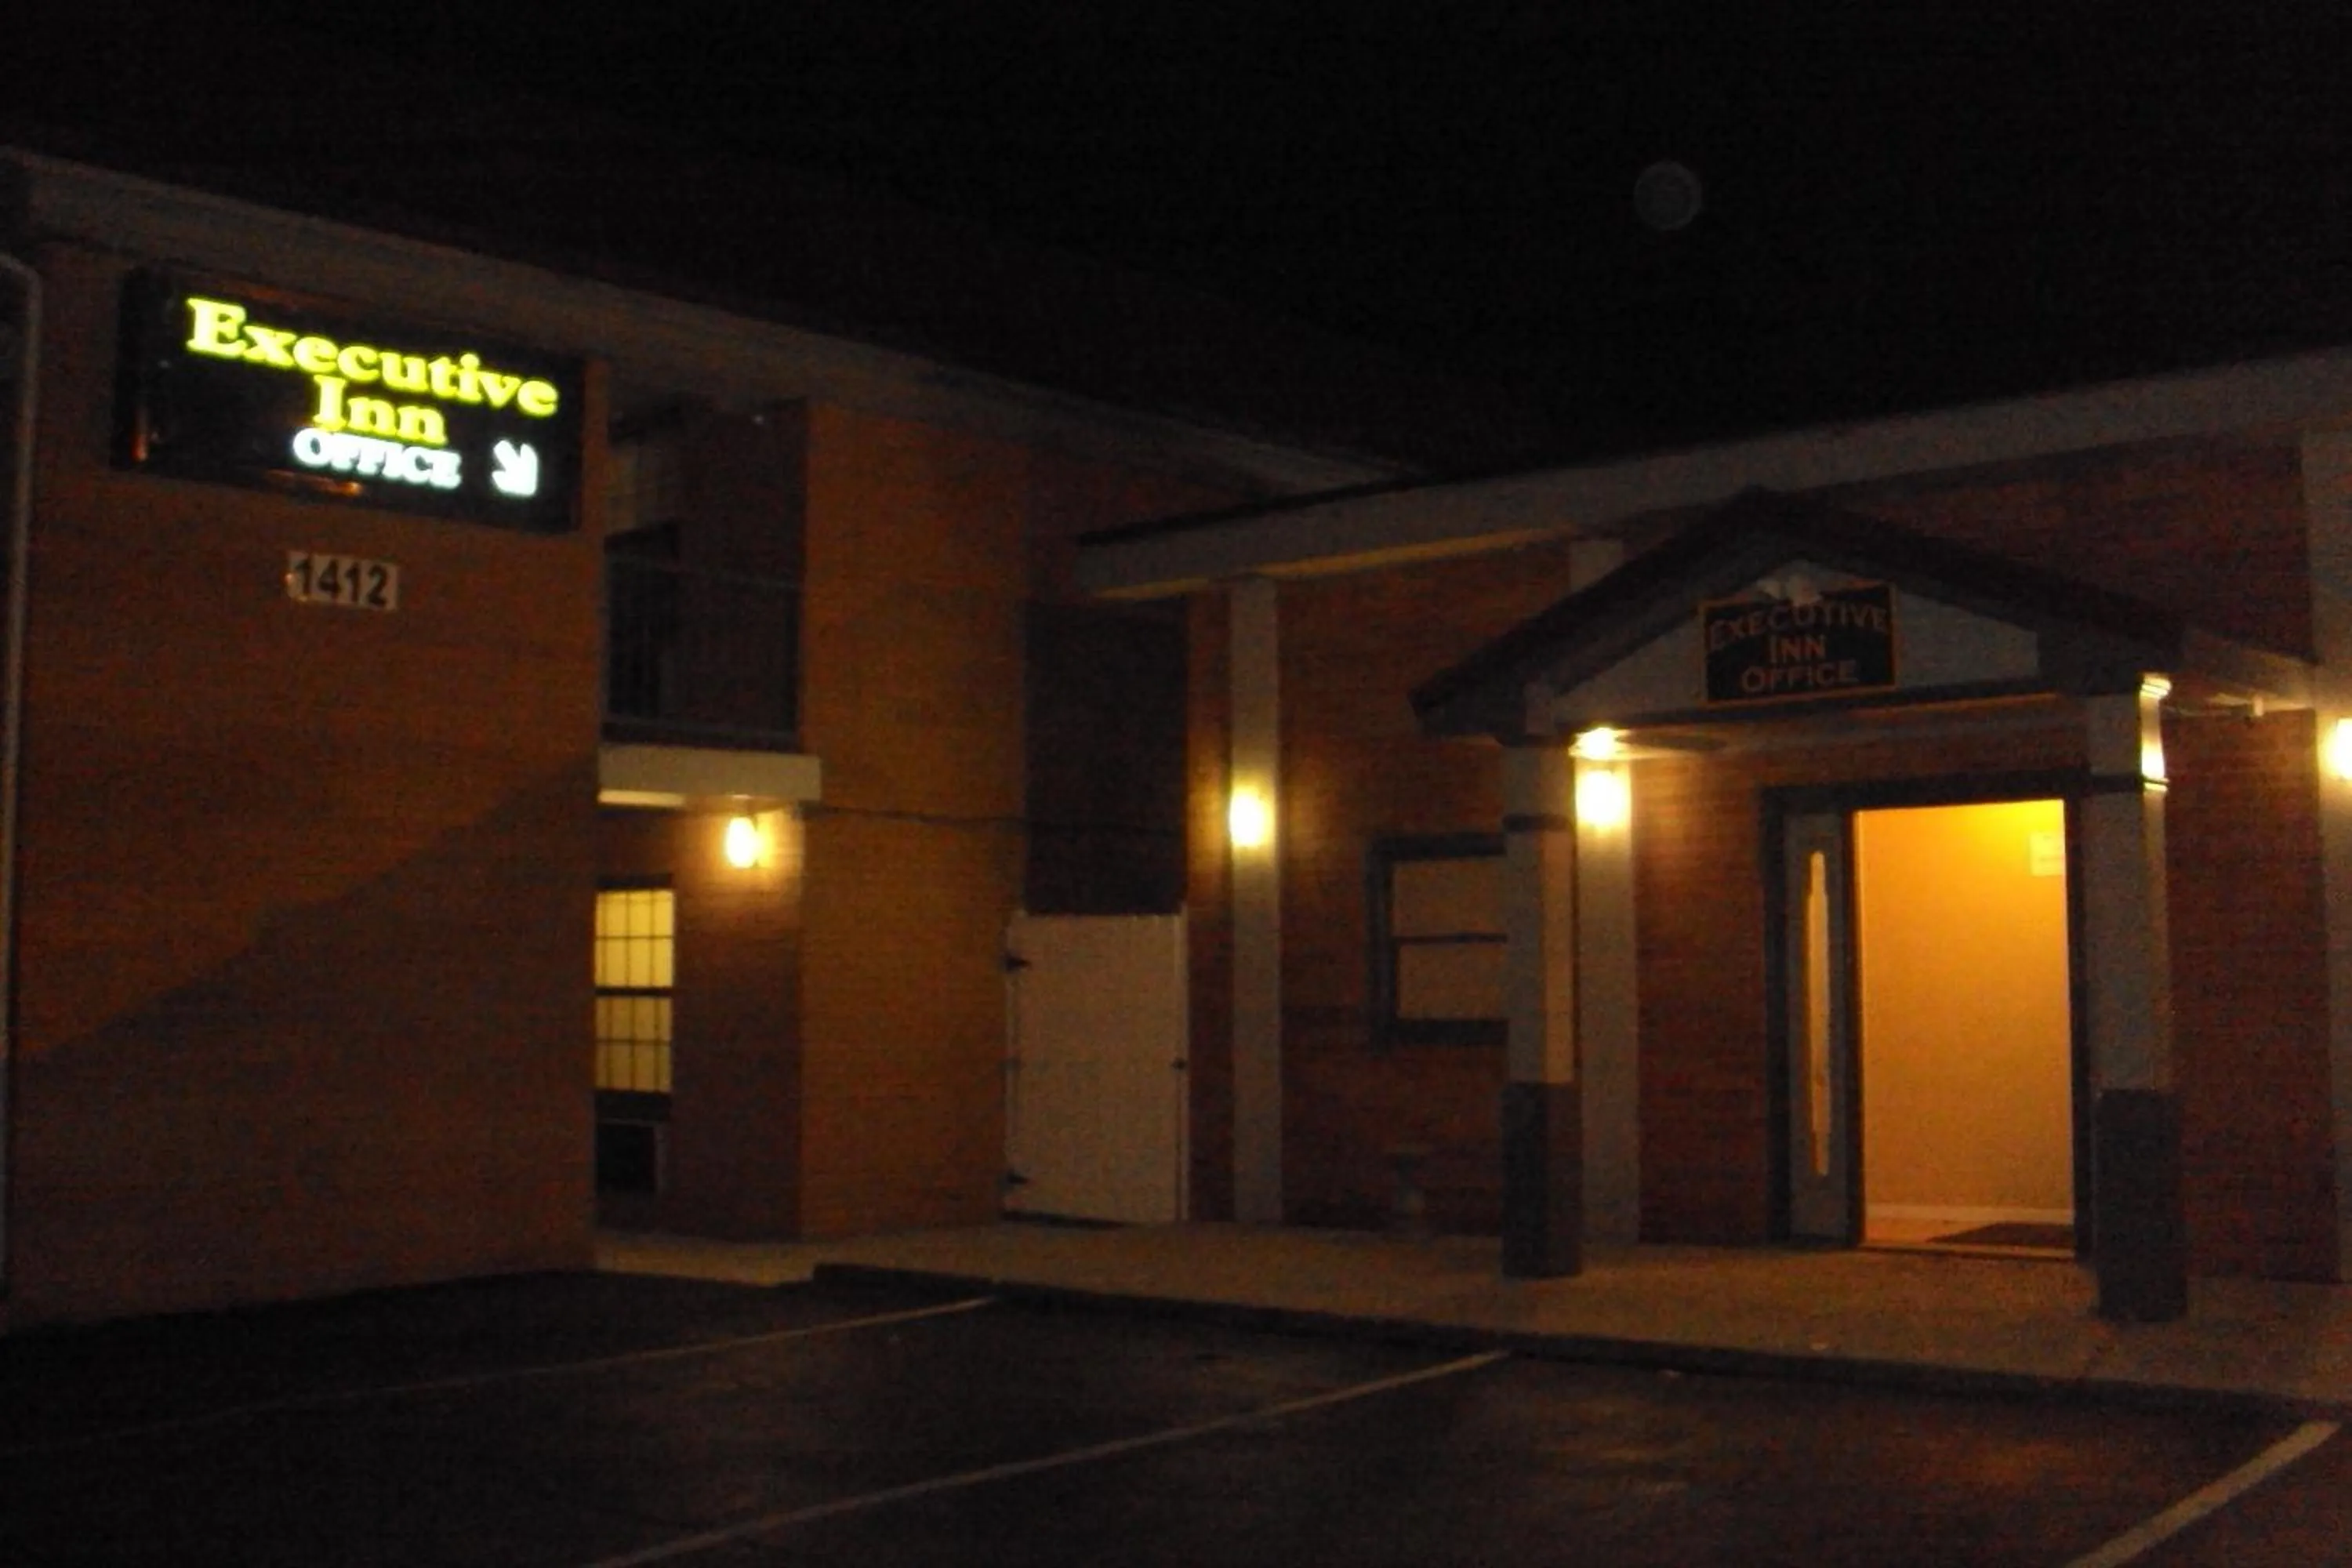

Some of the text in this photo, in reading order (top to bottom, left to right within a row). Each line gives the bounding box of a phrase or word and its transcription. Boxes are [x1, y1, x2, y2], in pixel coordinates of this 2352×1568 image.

[186, 297, 558, 418] Executive
[314, 374, 448, 445] Inn
[292, 427, 462, 489] OFFICE
[293, 559, 387, 605] 1412
[1709, 601, 1889, 652] EXECUTIVE
[1768, 633, 1828, 663] INN
[1740, 659, 1860, 693] OFFICE
